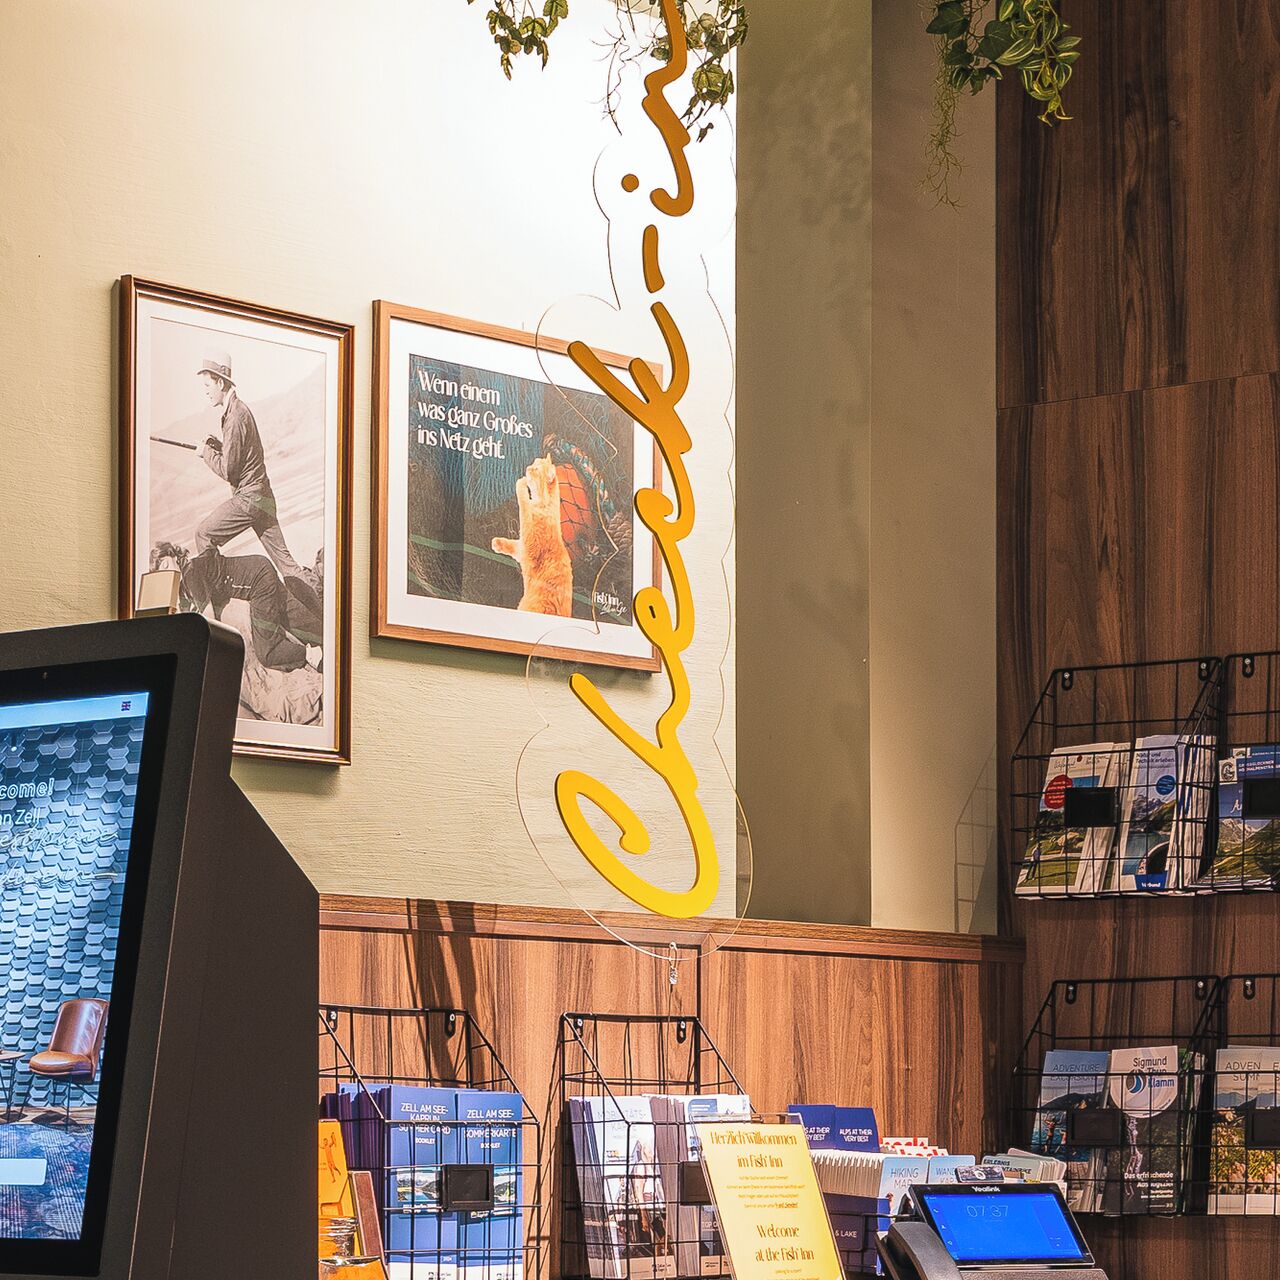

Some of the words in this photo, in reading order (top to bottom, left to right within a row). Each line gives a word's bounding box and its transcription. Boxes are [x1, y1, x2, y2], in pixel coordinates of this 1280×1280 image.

[418, 370, 458, 397] Wenn
[460, 382, 500, 406] einem
[417, 402, 445, 421] was
[448, 407, 480, 428] ganz
[483, 411, 533, 438] Großes
[417, 425, 437, 447] ins
[440, 428, 470, 453] Netz
[472, 436, 505, 459] geht.
[555, 0, 719, 918] Check-in
[15, 807, 41, 825] Zell
[1053, 1063, 1100, 1072] ADVENTURE
[1133, 1056, 1167, 1068] Sigmund
[401, 1102, 419, 1113] ZELL
[420, 1104, 432, 1113] AM
[433, 1105, 449, 1115] SEE-
[467, 1109, 485, 1119] ZELL
[486, 1109, 497, 1118] AM
[498, 1109, 515, 1118] SEE-
[710, 1130, 745, 1145] Herzlich
[746, 1130, 797, 1145] willkommen
[857, 1135, 869, 1143] BEST
[737, 1154, 749, 1167] im
[769, 1154, 783, 1167] Inn
[890, 1167, 919, 1178] HIKING
[756, 1223, 800, 1238] Welcome
[840, 1230, 857, 1238] LAKE
[755, 1248, 764, 1262] at
[765, 1247, 779, 1261] the
[800, 1247, 815, 1260] Inn
